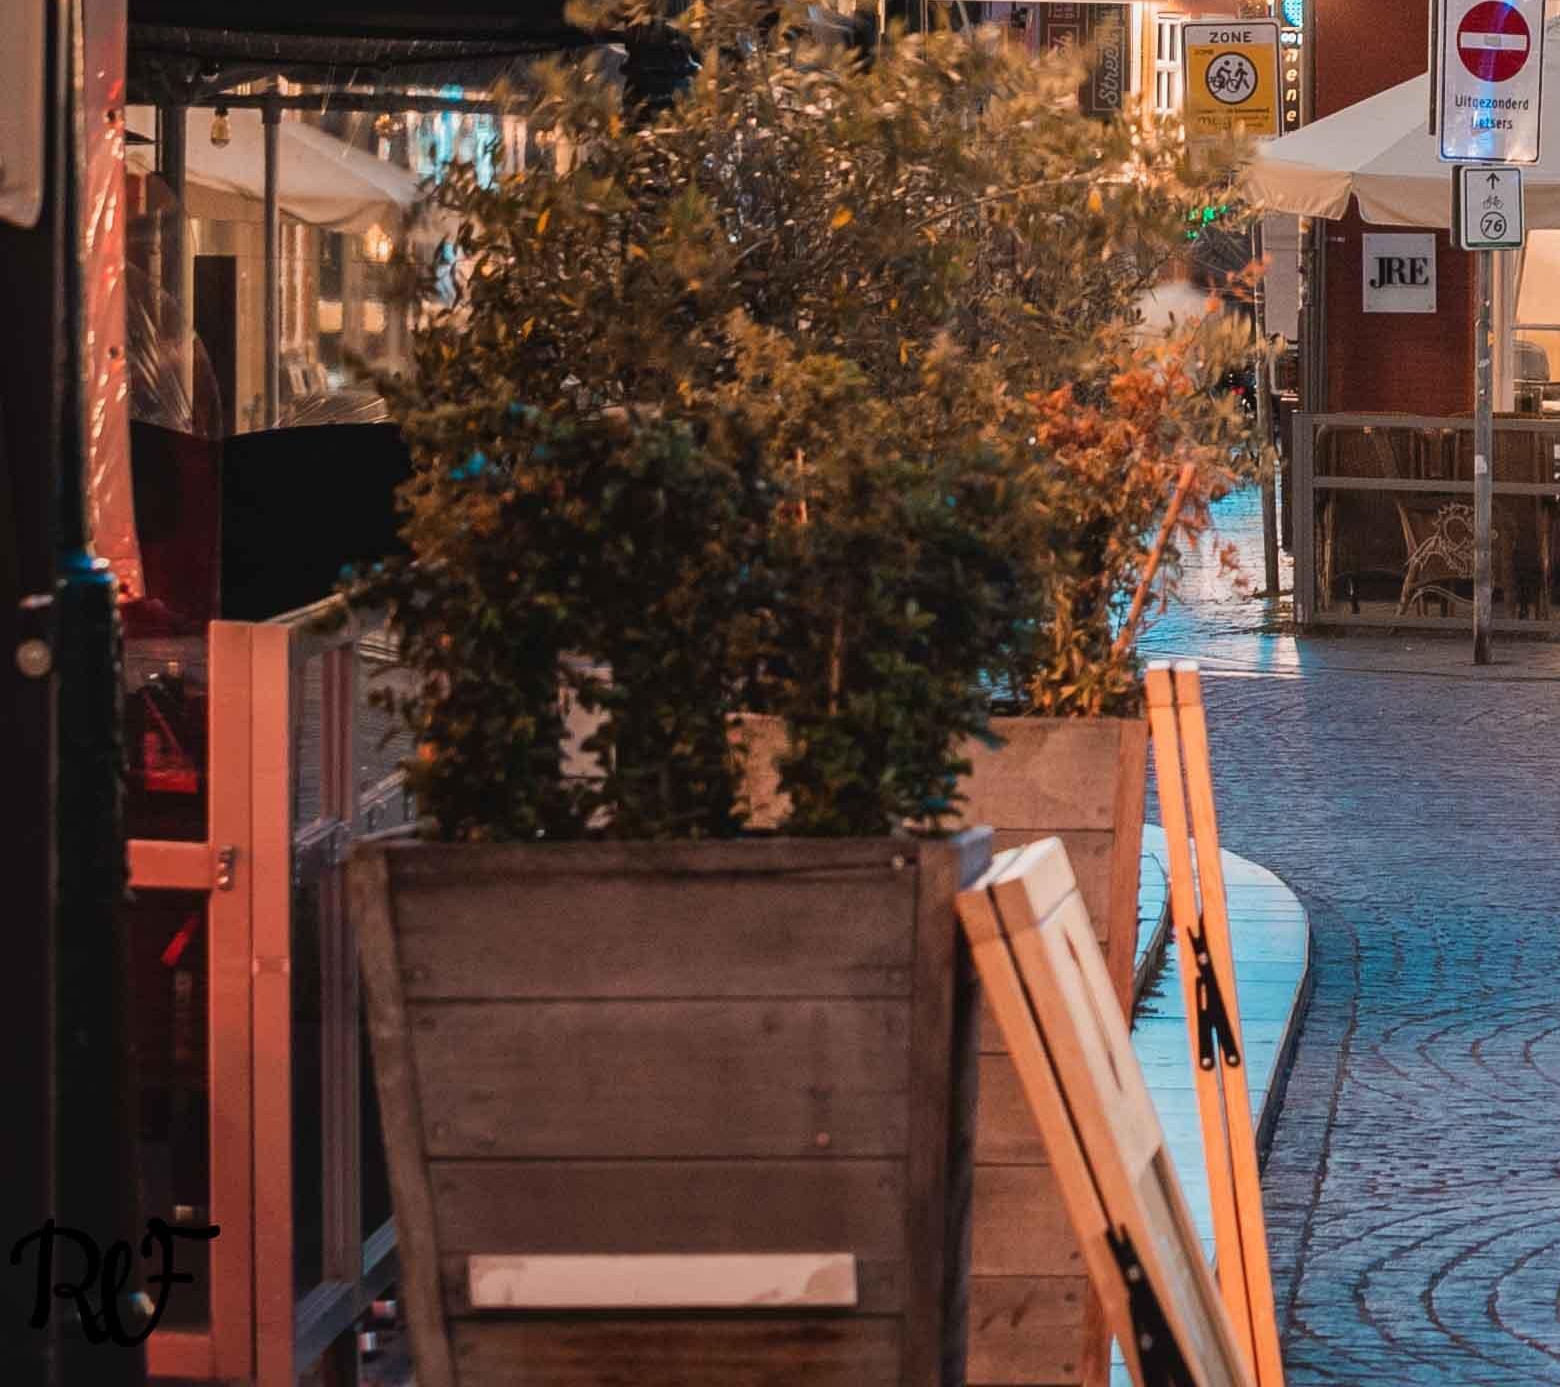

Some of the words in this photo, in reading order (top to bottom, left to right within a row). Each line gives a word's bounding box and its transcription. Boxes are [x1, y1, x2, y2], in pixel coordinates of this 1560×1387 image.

[1209, 31, 1252, 43] ZONE
[1455, 94, 1529, 110] Uitgezonderd
[1484, 219, 1503, 232] 76
[1369, 257, 1430, 289] JRE
